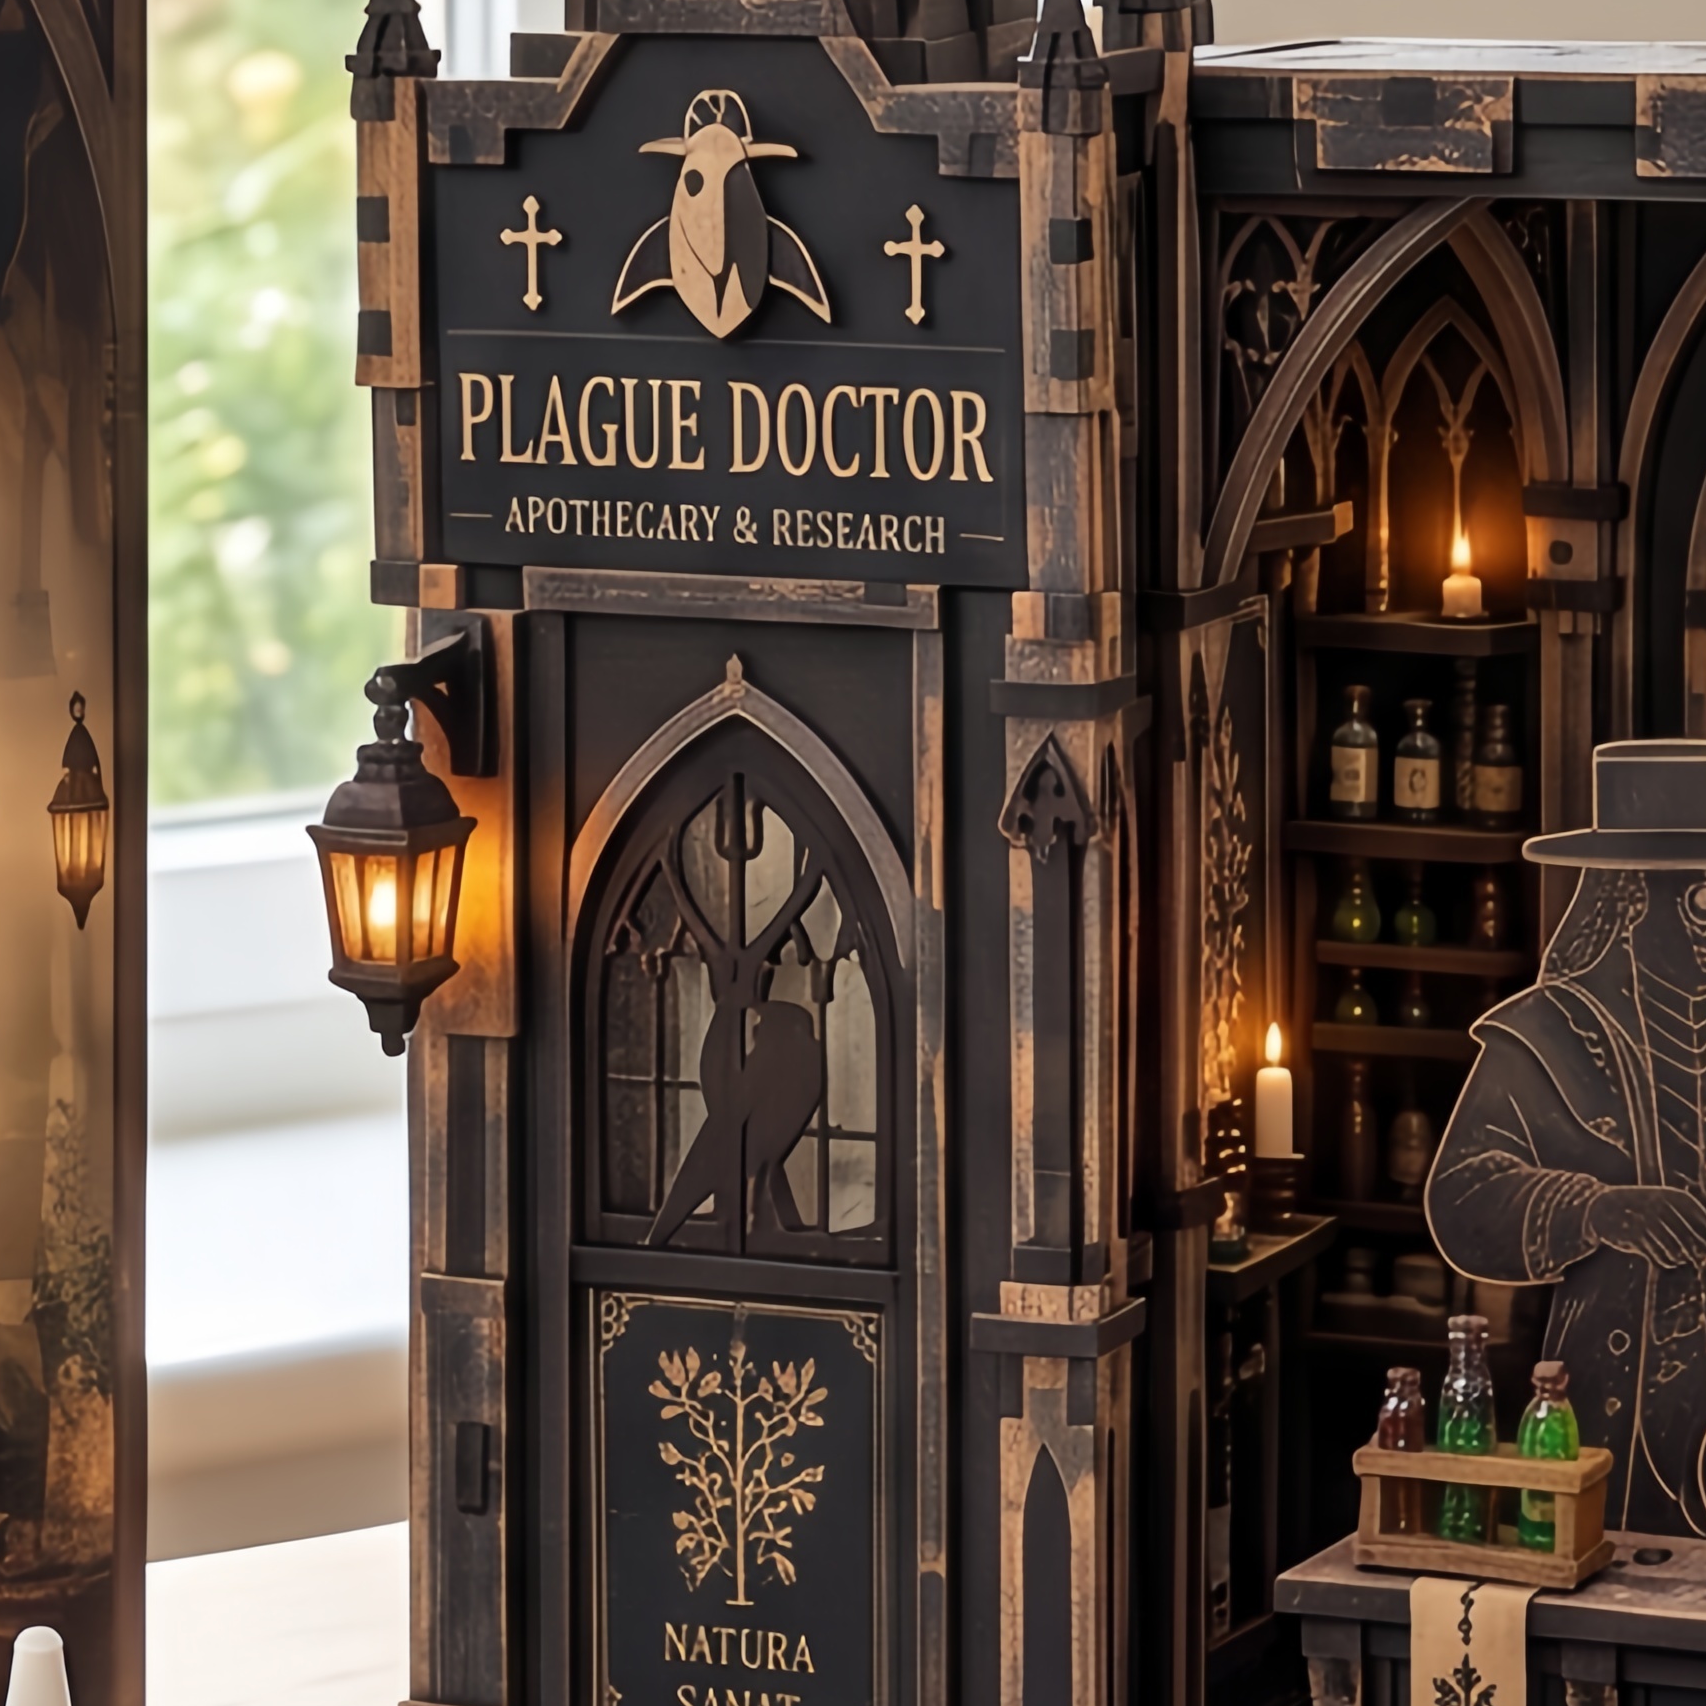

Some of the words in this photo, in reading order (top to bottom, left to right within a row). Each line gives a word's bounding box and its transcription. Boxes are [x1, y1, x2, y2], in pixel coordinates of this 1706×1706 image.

[458, 372, 705, 471] PLAGUE
[728, 380, 994, 483] DOCTOR
[505, 496, 720, 543] APOTHECARY
[732, 506, 758, 544] &
[773, 509, 946, 555] RESEARCH
[664, 1622, 815, 1674] NATURA
